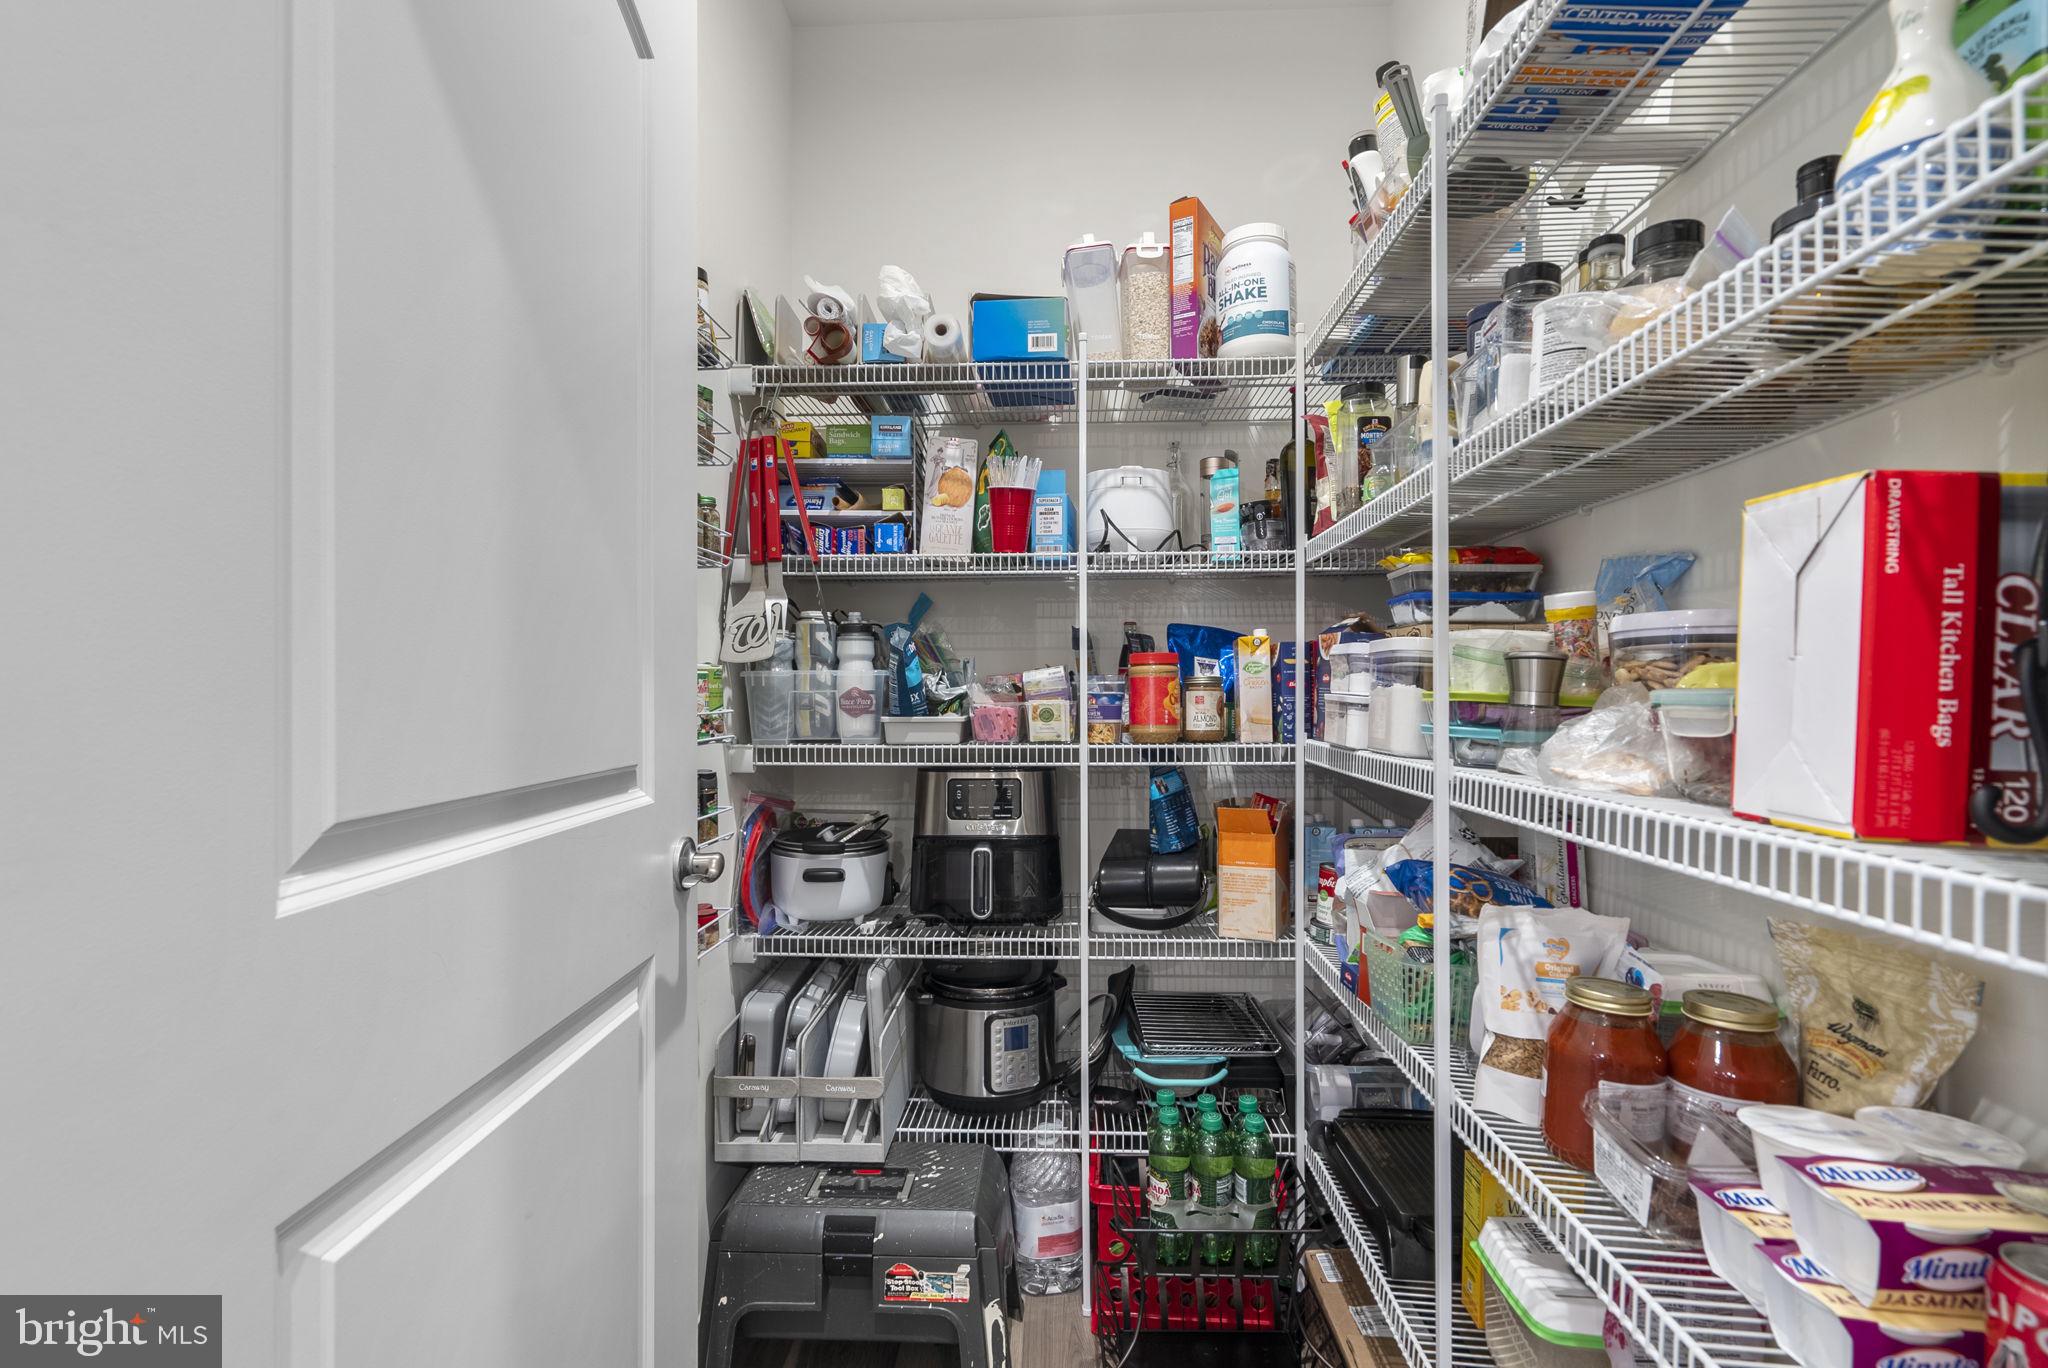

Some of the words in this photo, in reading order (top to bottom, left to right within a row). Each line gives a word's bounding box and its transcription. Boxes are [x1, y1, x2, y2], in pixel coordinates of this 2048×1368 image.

[1643, 12, 1729, 29] KITCEN
[1538, 87, 1566, 95] FRESH
[1567, 87, 1595, 95] SCENT
[1515, 99, 1549, 114] 13
[1218, 277, 1265, 298] ALL-IN-ONE
[1218, 286, 1267, 312] SHAKE
[1885, 477, 1902, 574] DRAWSTRING
[929, 533, 963, 545] GALETTE
[1943, 563, 1966, 604] Tall
[1939, 611, 1964, 692] Kitchen
[1192, 715, 1217, 723] ALMOND
[1931, 699, 1959, 748] Bags
[2004, 776, 2031, 823] 120
[1544, 963, 1574, 973] Original
[1826, 1022, 1890, 1058] Wegmans
[1806, 1060, 1841, 1092] Farro.
[738, 1083, 769, 1092] Caraway
[825, 1084, 856, 1093] Caraway
[1813, 1164, 1921, 1184] Minute
[1847, 1195, 1963, 1213] JASMINE
[1908, 1255, 1989, 1281] Minut
[1880, 1293, 1984, 1310] JASMIN
